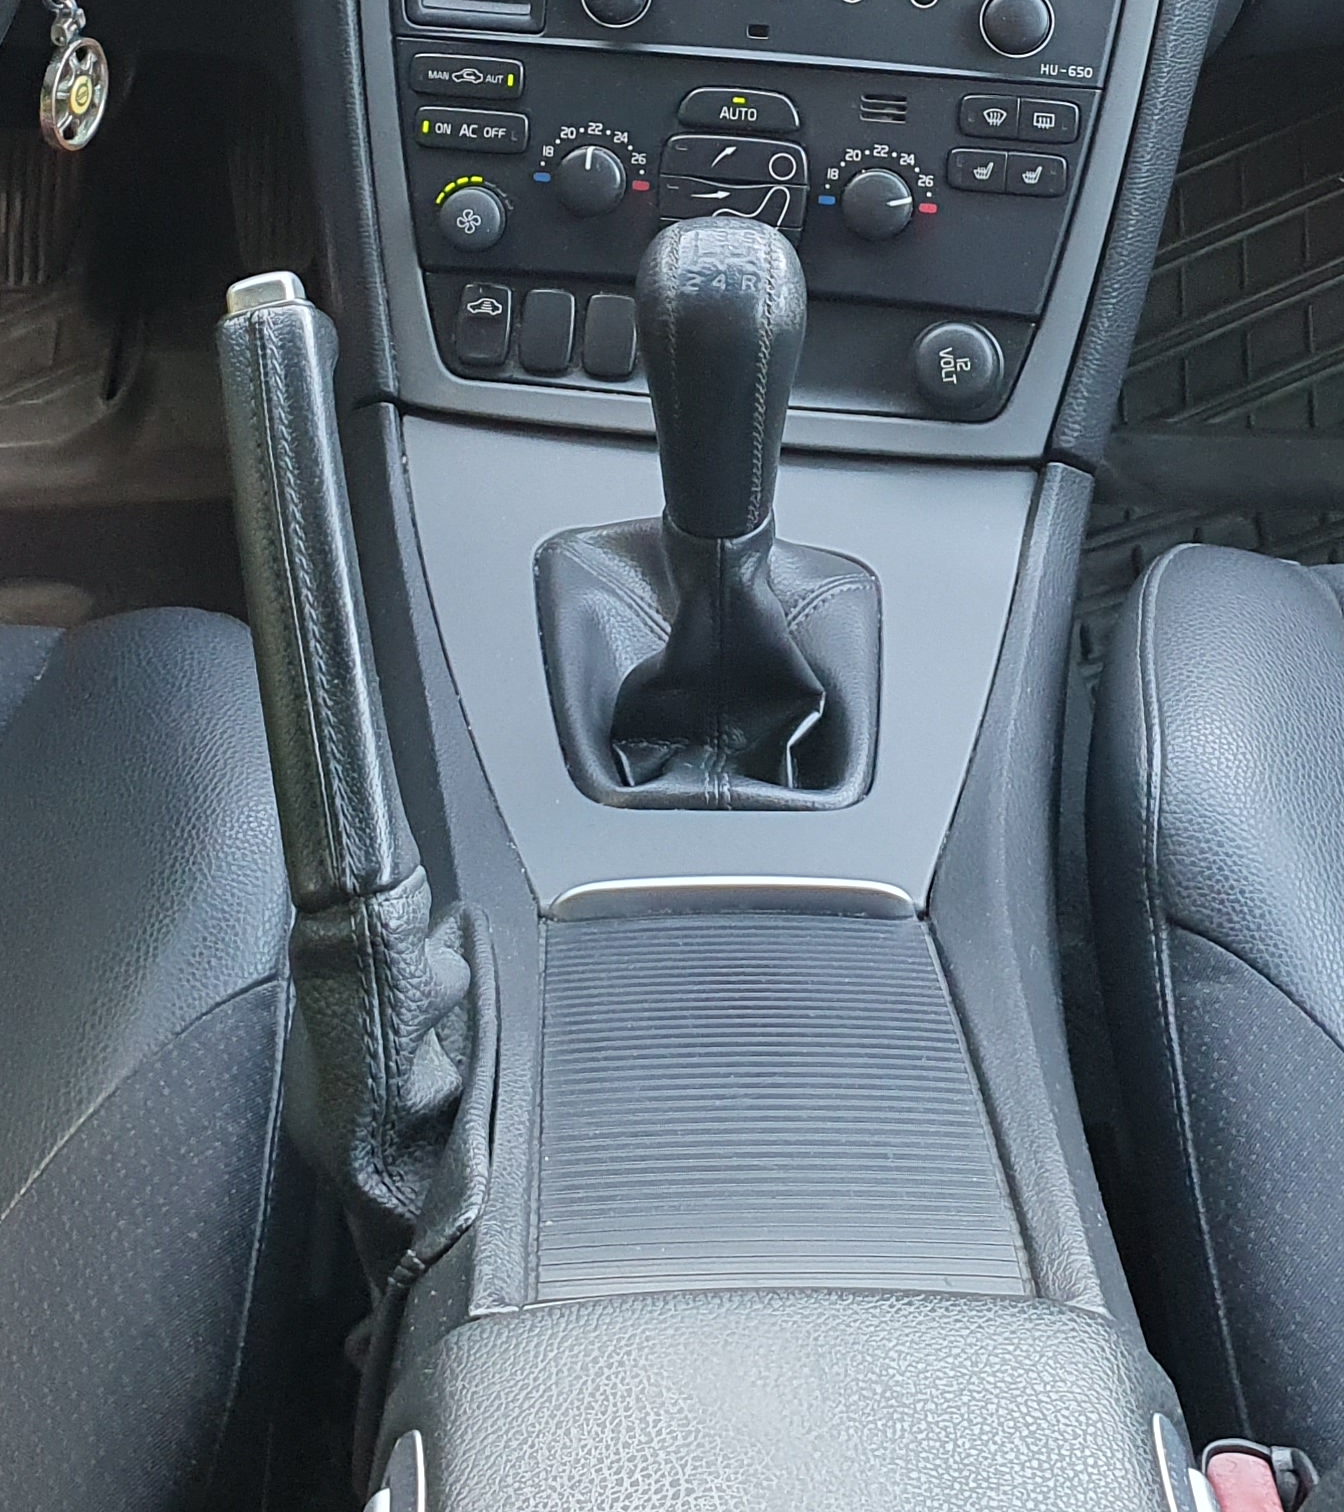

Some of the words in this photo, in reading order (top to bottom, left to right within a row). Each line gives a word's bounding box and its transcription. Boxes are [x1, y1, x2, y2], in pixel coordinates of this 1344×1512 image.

[428, 70, 450, 80] MAN
[485, 75, 504, 84] AUT
[1040, 64, 1093, 78] HU-650
[719, 106, 757, 121] AUTO
[435, 122, 452, 135] ON
[459, 124, 478, 138] AC
[483, 127, 507, 139] OFF
[560, 126, 576, 139] 20
[587, 122, 603, 135] 22
[613, 131, 628, 144] 24
[542, 145, 554, 157] 18
[845, 149, 862, 161] 20
[872, 144, 889, 158] 22
[631, 152, 647, 165] 26
[899, 153, 915, 166] 24
[827, 168, 839, 180] 18
[917, 174, 934, 187] 26
[711, 273, 726, 291] 4
[741, 274, 758, 292] R
[939, 347, 957, 384] VOLT
[956, 358, 971, 371] 12
